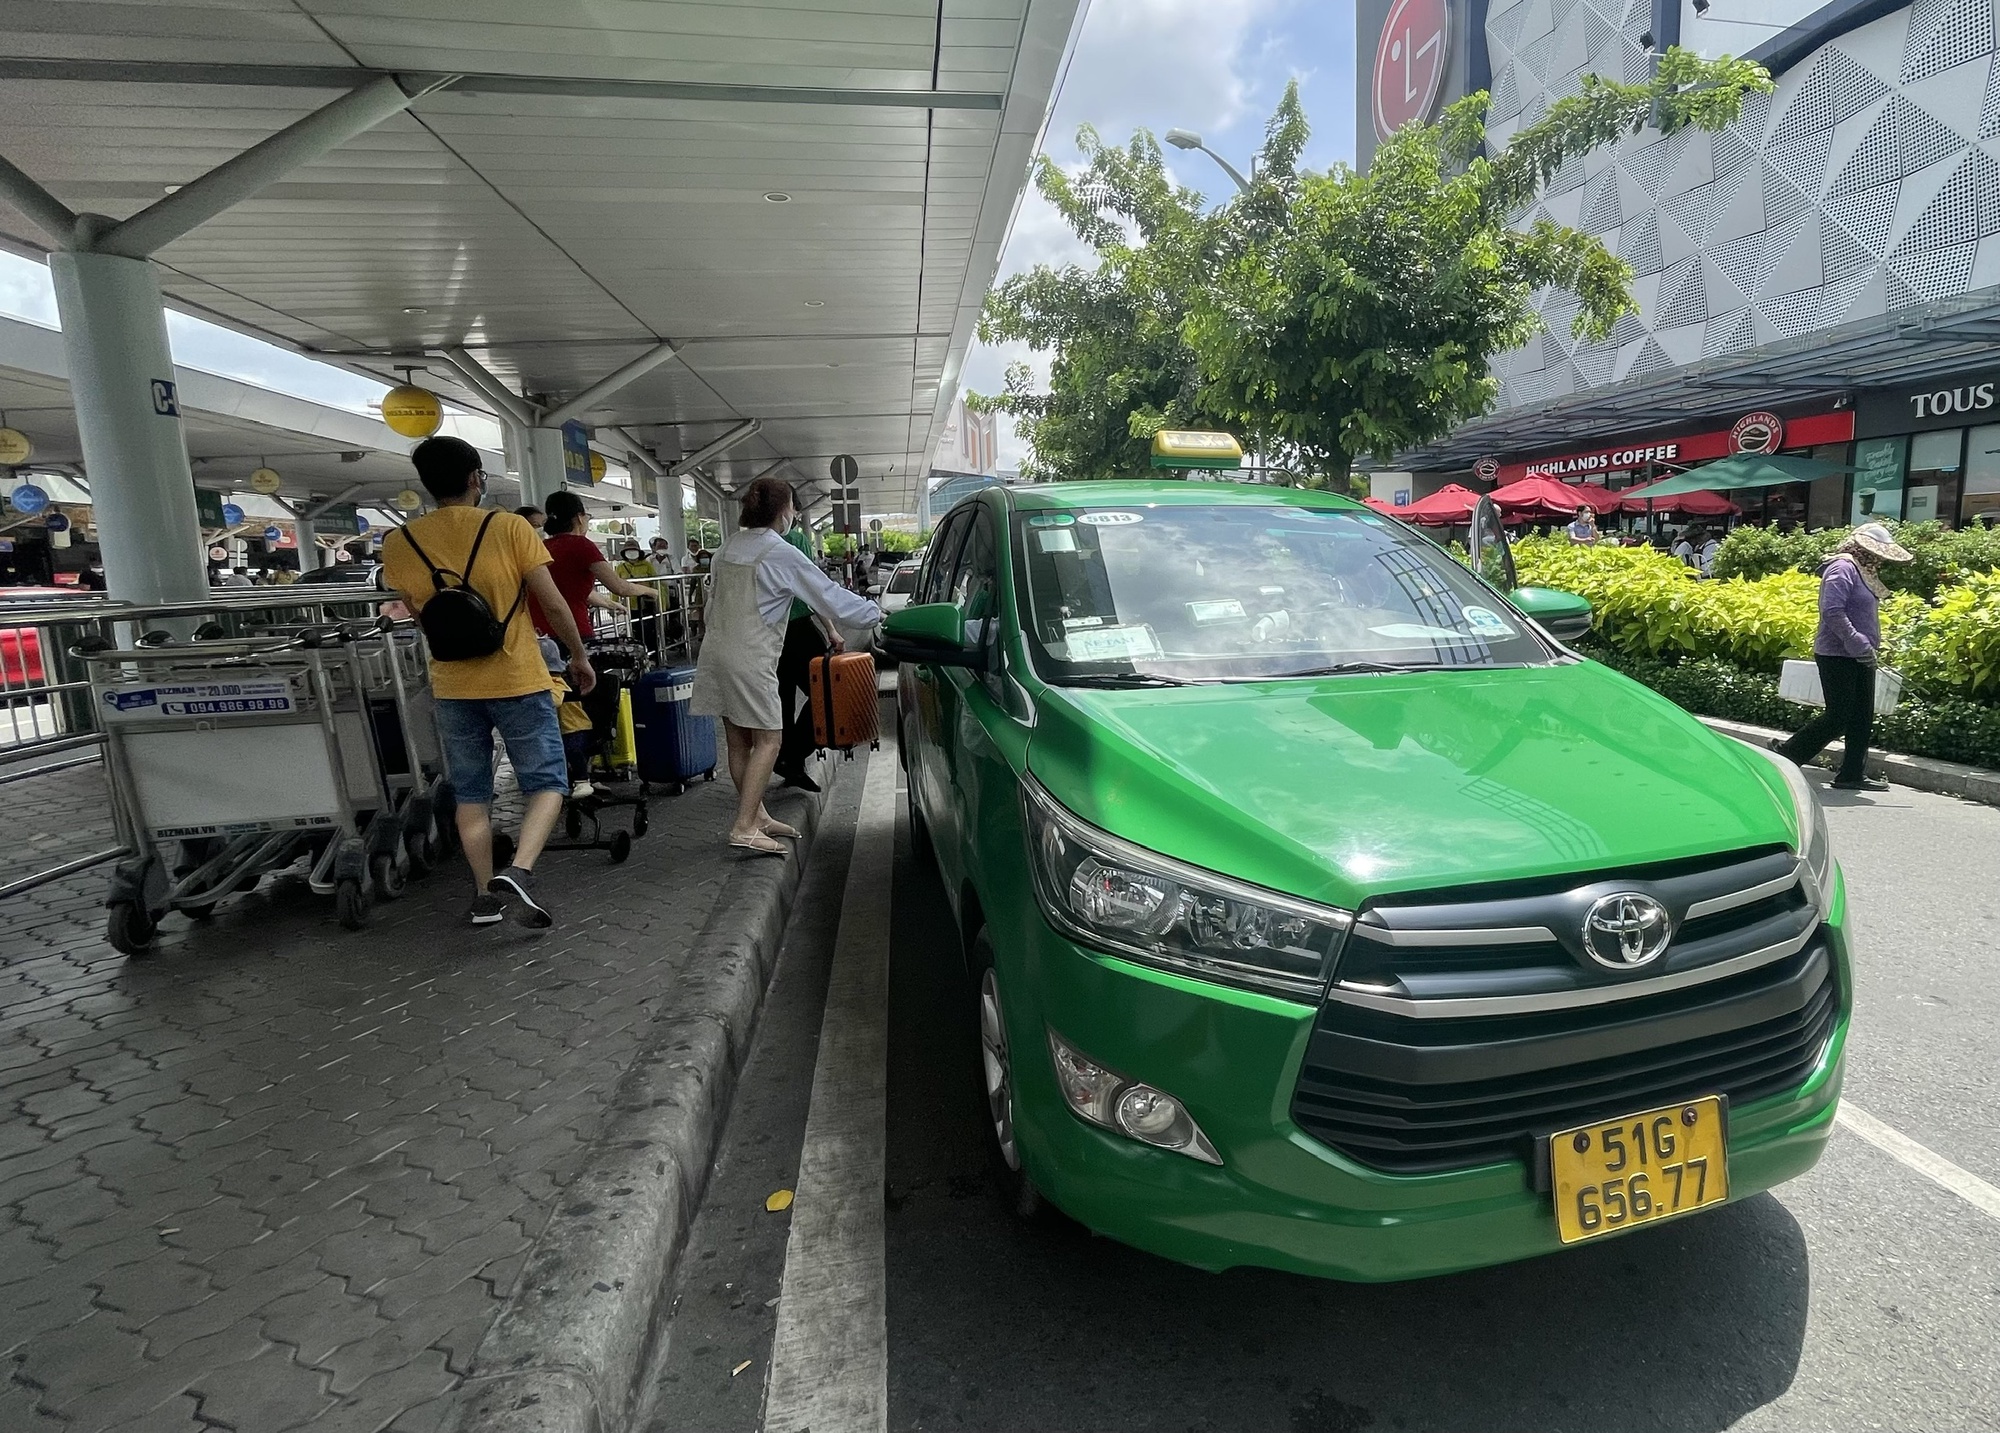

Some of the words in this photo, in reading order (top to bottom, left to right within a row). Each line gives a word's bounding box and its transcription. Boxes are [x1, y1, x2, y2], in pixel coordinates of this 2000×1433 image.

[1910, 382, 1994, 419] TOUS
[1732, 414, 1780, 440] HIGHLANDS
[1526, 454, 1608, 475] HIGHLANDS
[1611, 444, 1677, 465] COFFEE
[1086, 514, 1132, 523] 5813
[207, 684, 241, 697] 20.000
[157, 826, 216, 838] BIZMAN.VN
[1601, 1116, 1676, 1172] 51G
[1576, 1155, 1708, 1230] 656.77
